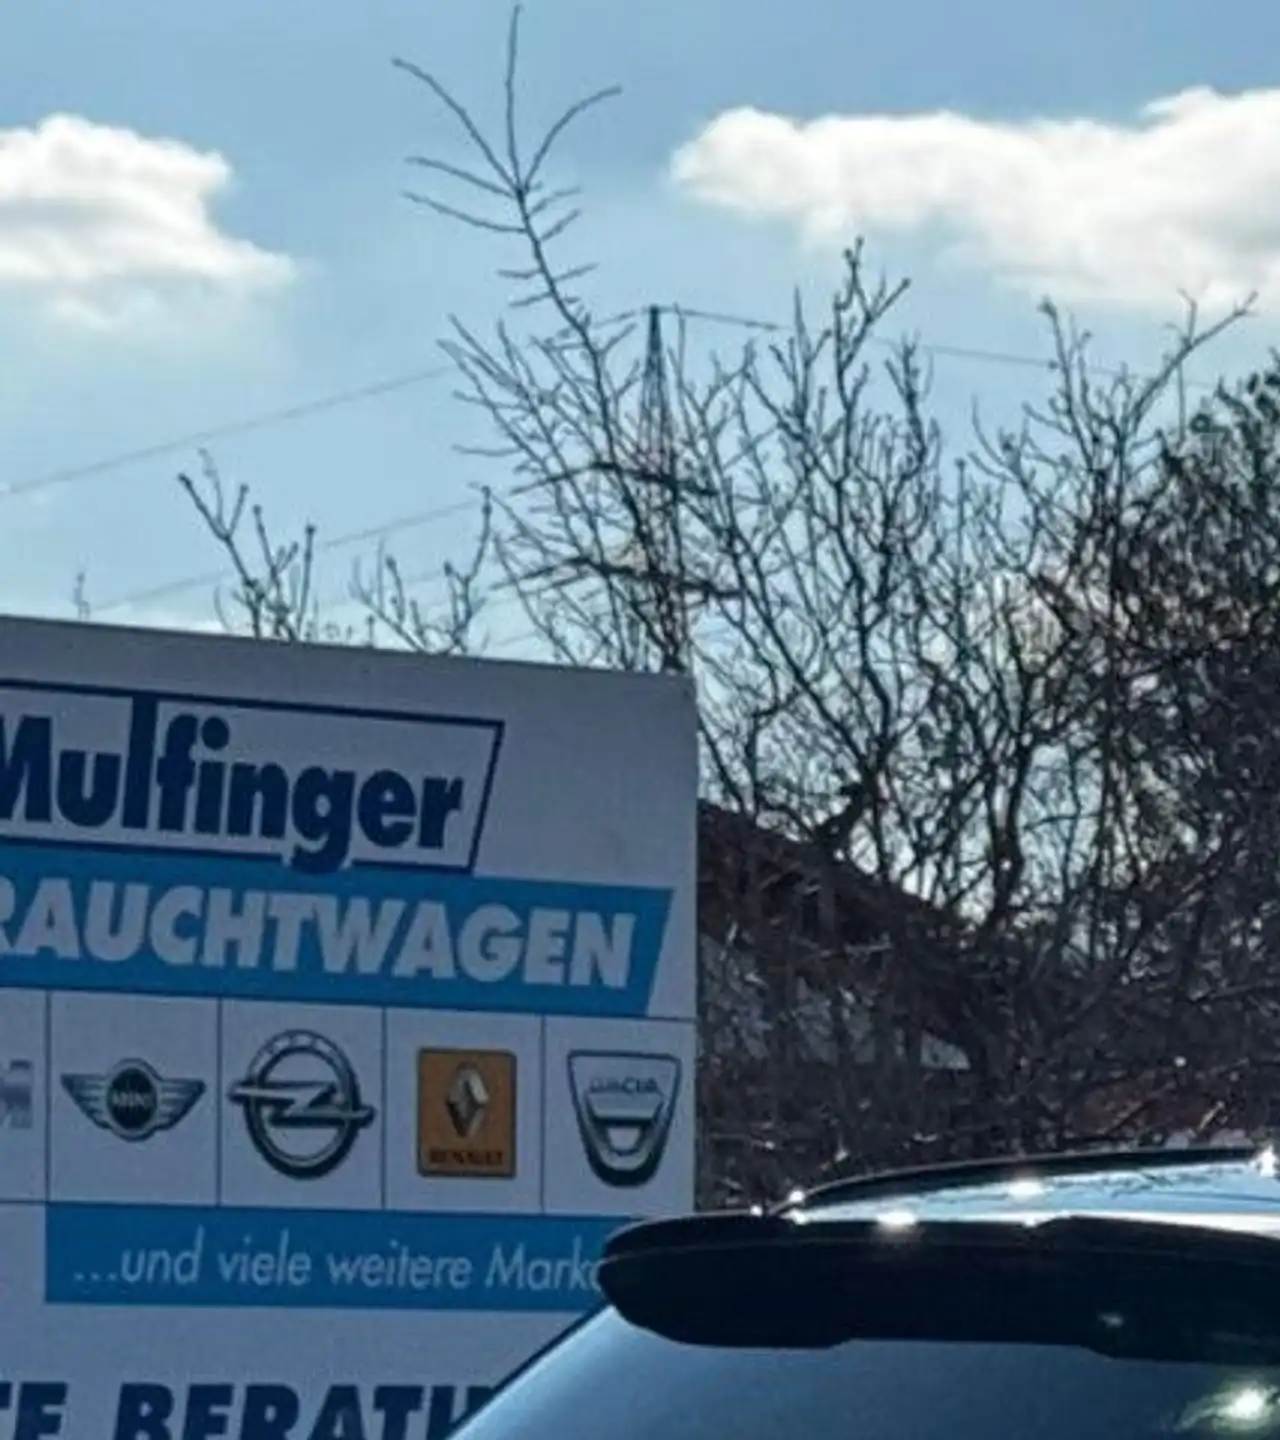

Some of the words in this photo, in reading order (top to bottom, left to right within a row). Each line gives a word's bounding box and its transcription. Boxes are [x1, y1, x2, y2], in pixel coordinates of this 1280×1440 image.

[217, 1227, 312, 1286] viele
[326, 1238, 473, 1290] weitere
[484, 1235, 602, 1291] Mark
